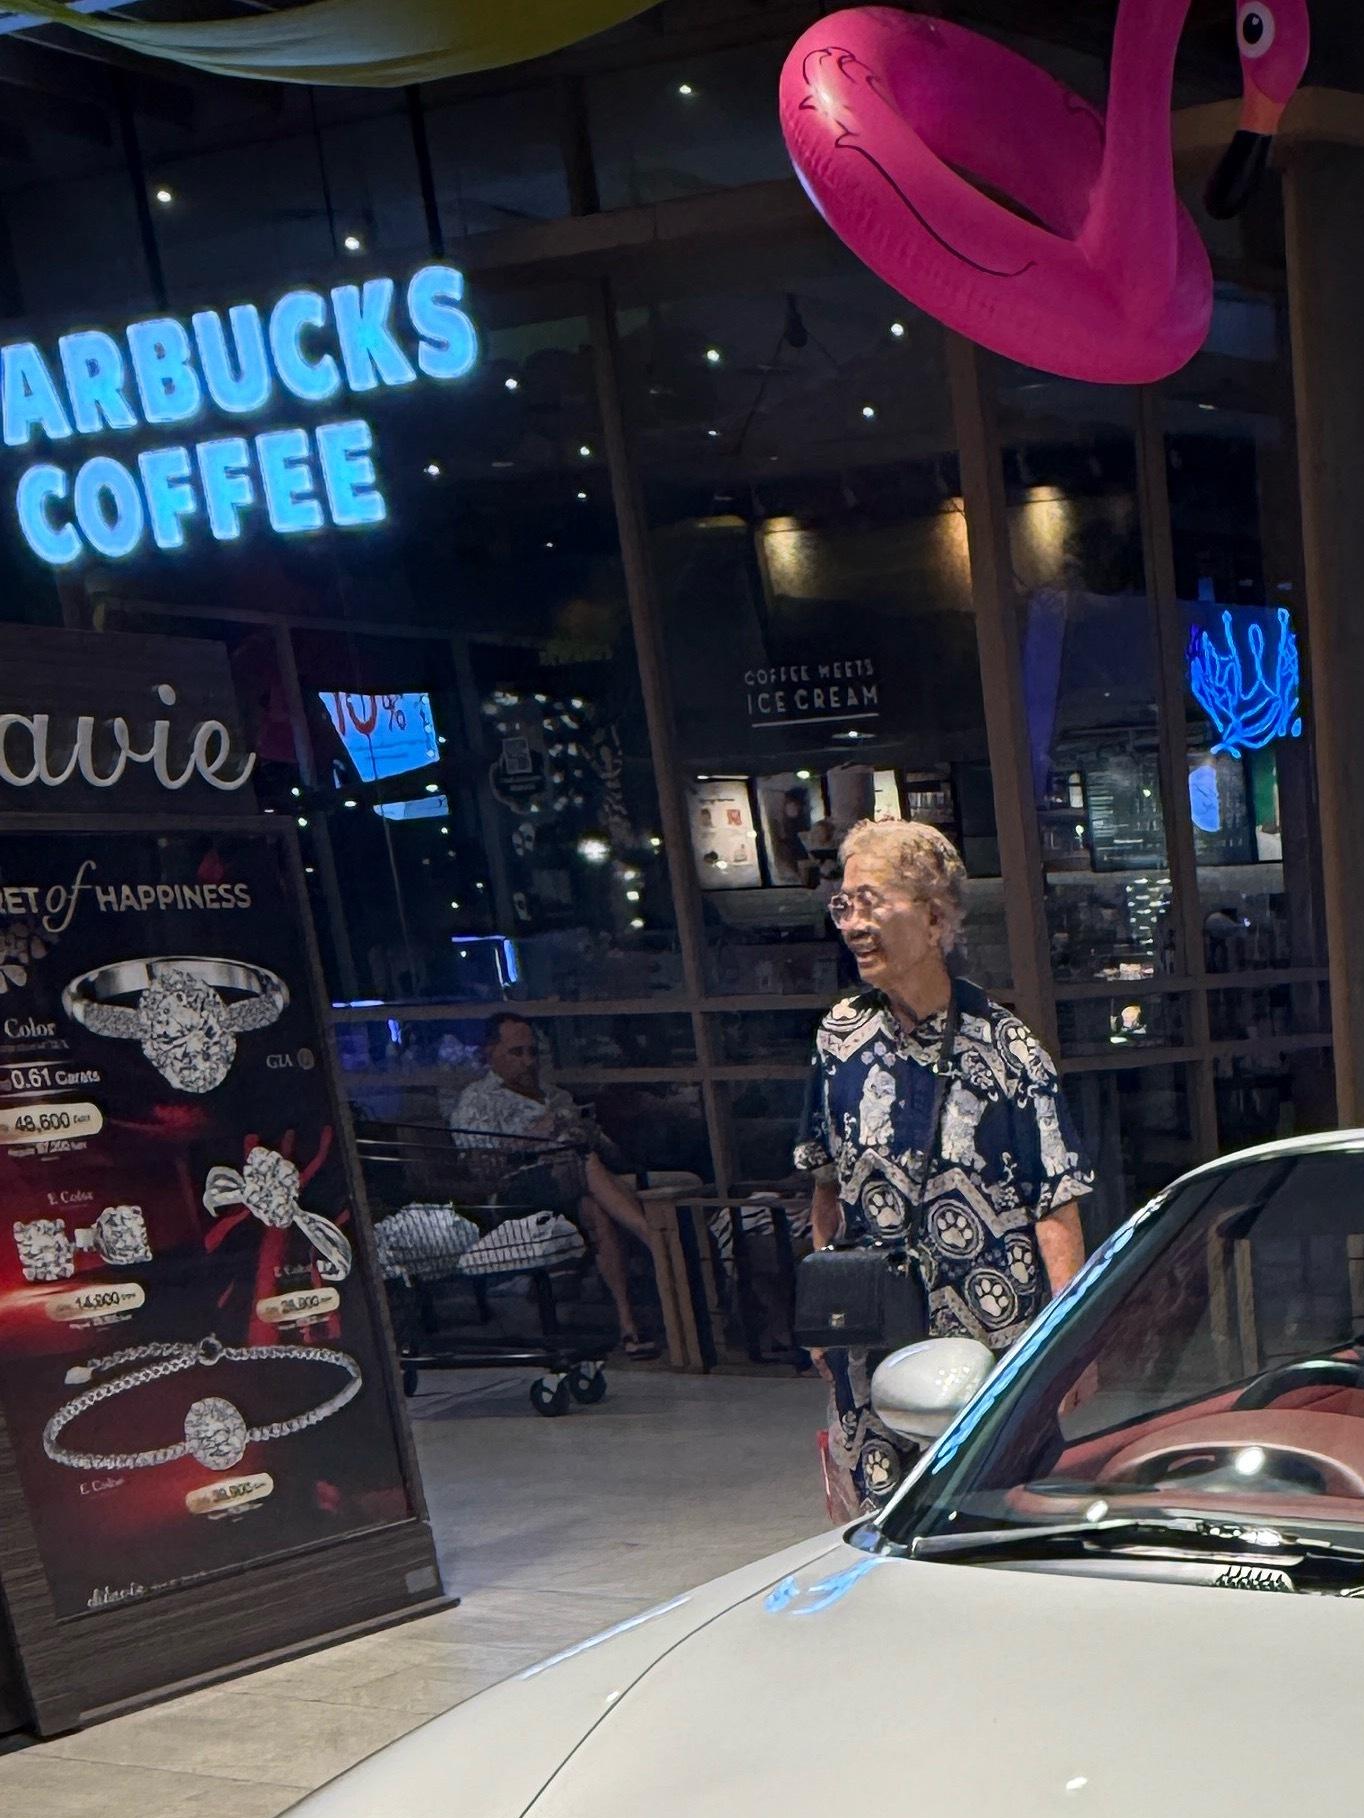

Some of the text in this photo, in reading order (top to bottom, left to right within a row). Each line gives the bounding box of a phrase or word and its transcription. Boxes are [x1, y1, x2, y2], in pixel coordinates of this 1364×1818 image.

[16, 420, 387, 565] COFFEE
[744, 659, 874, 685] COFFEE MEETS
[747, 685, 878, 714] ICE CREAM
[42, 860, 97, 933] of
[96, 883, 252, 913] HAPPINESS
[11, 1067, 52, 1090] 0.61
